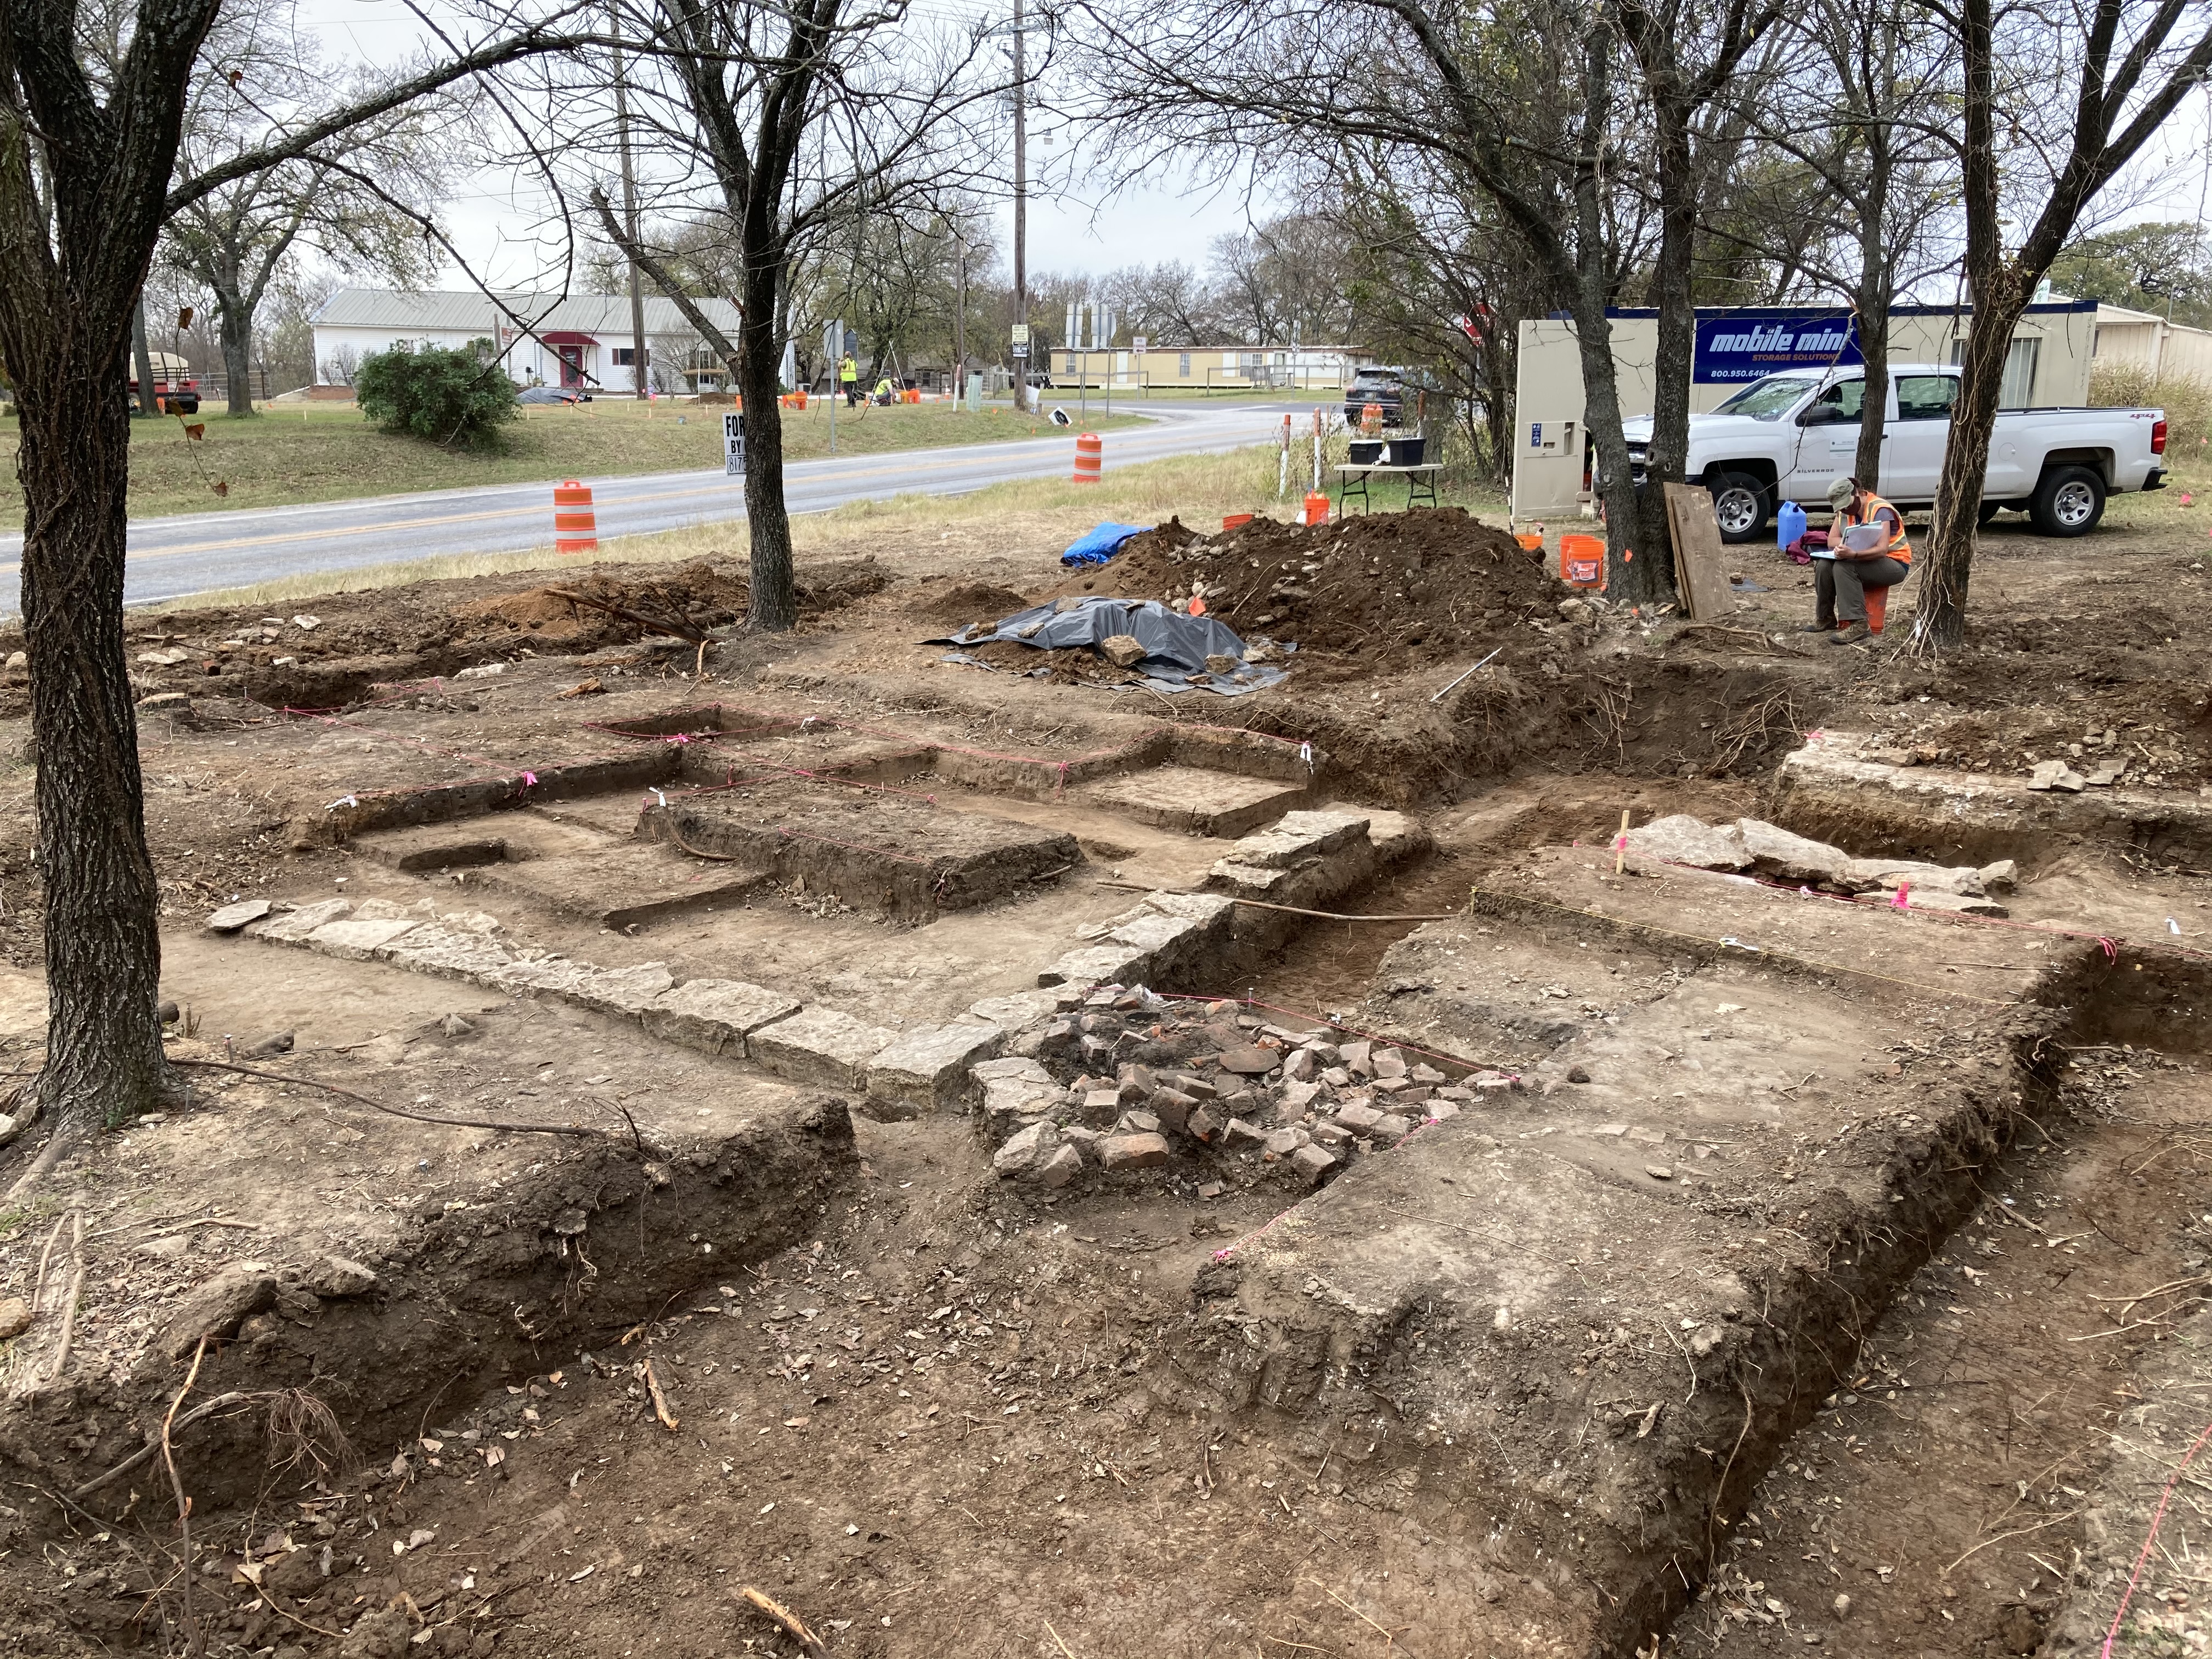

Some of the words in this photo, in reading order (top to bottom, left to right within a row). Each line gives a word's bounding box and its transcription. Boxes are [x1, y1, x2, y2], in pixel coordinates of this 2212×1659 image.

[1709, 325, 1794, 352] mobile
[726, 415, 746, 437] FOR
[731, 440, 741, 454] BY
